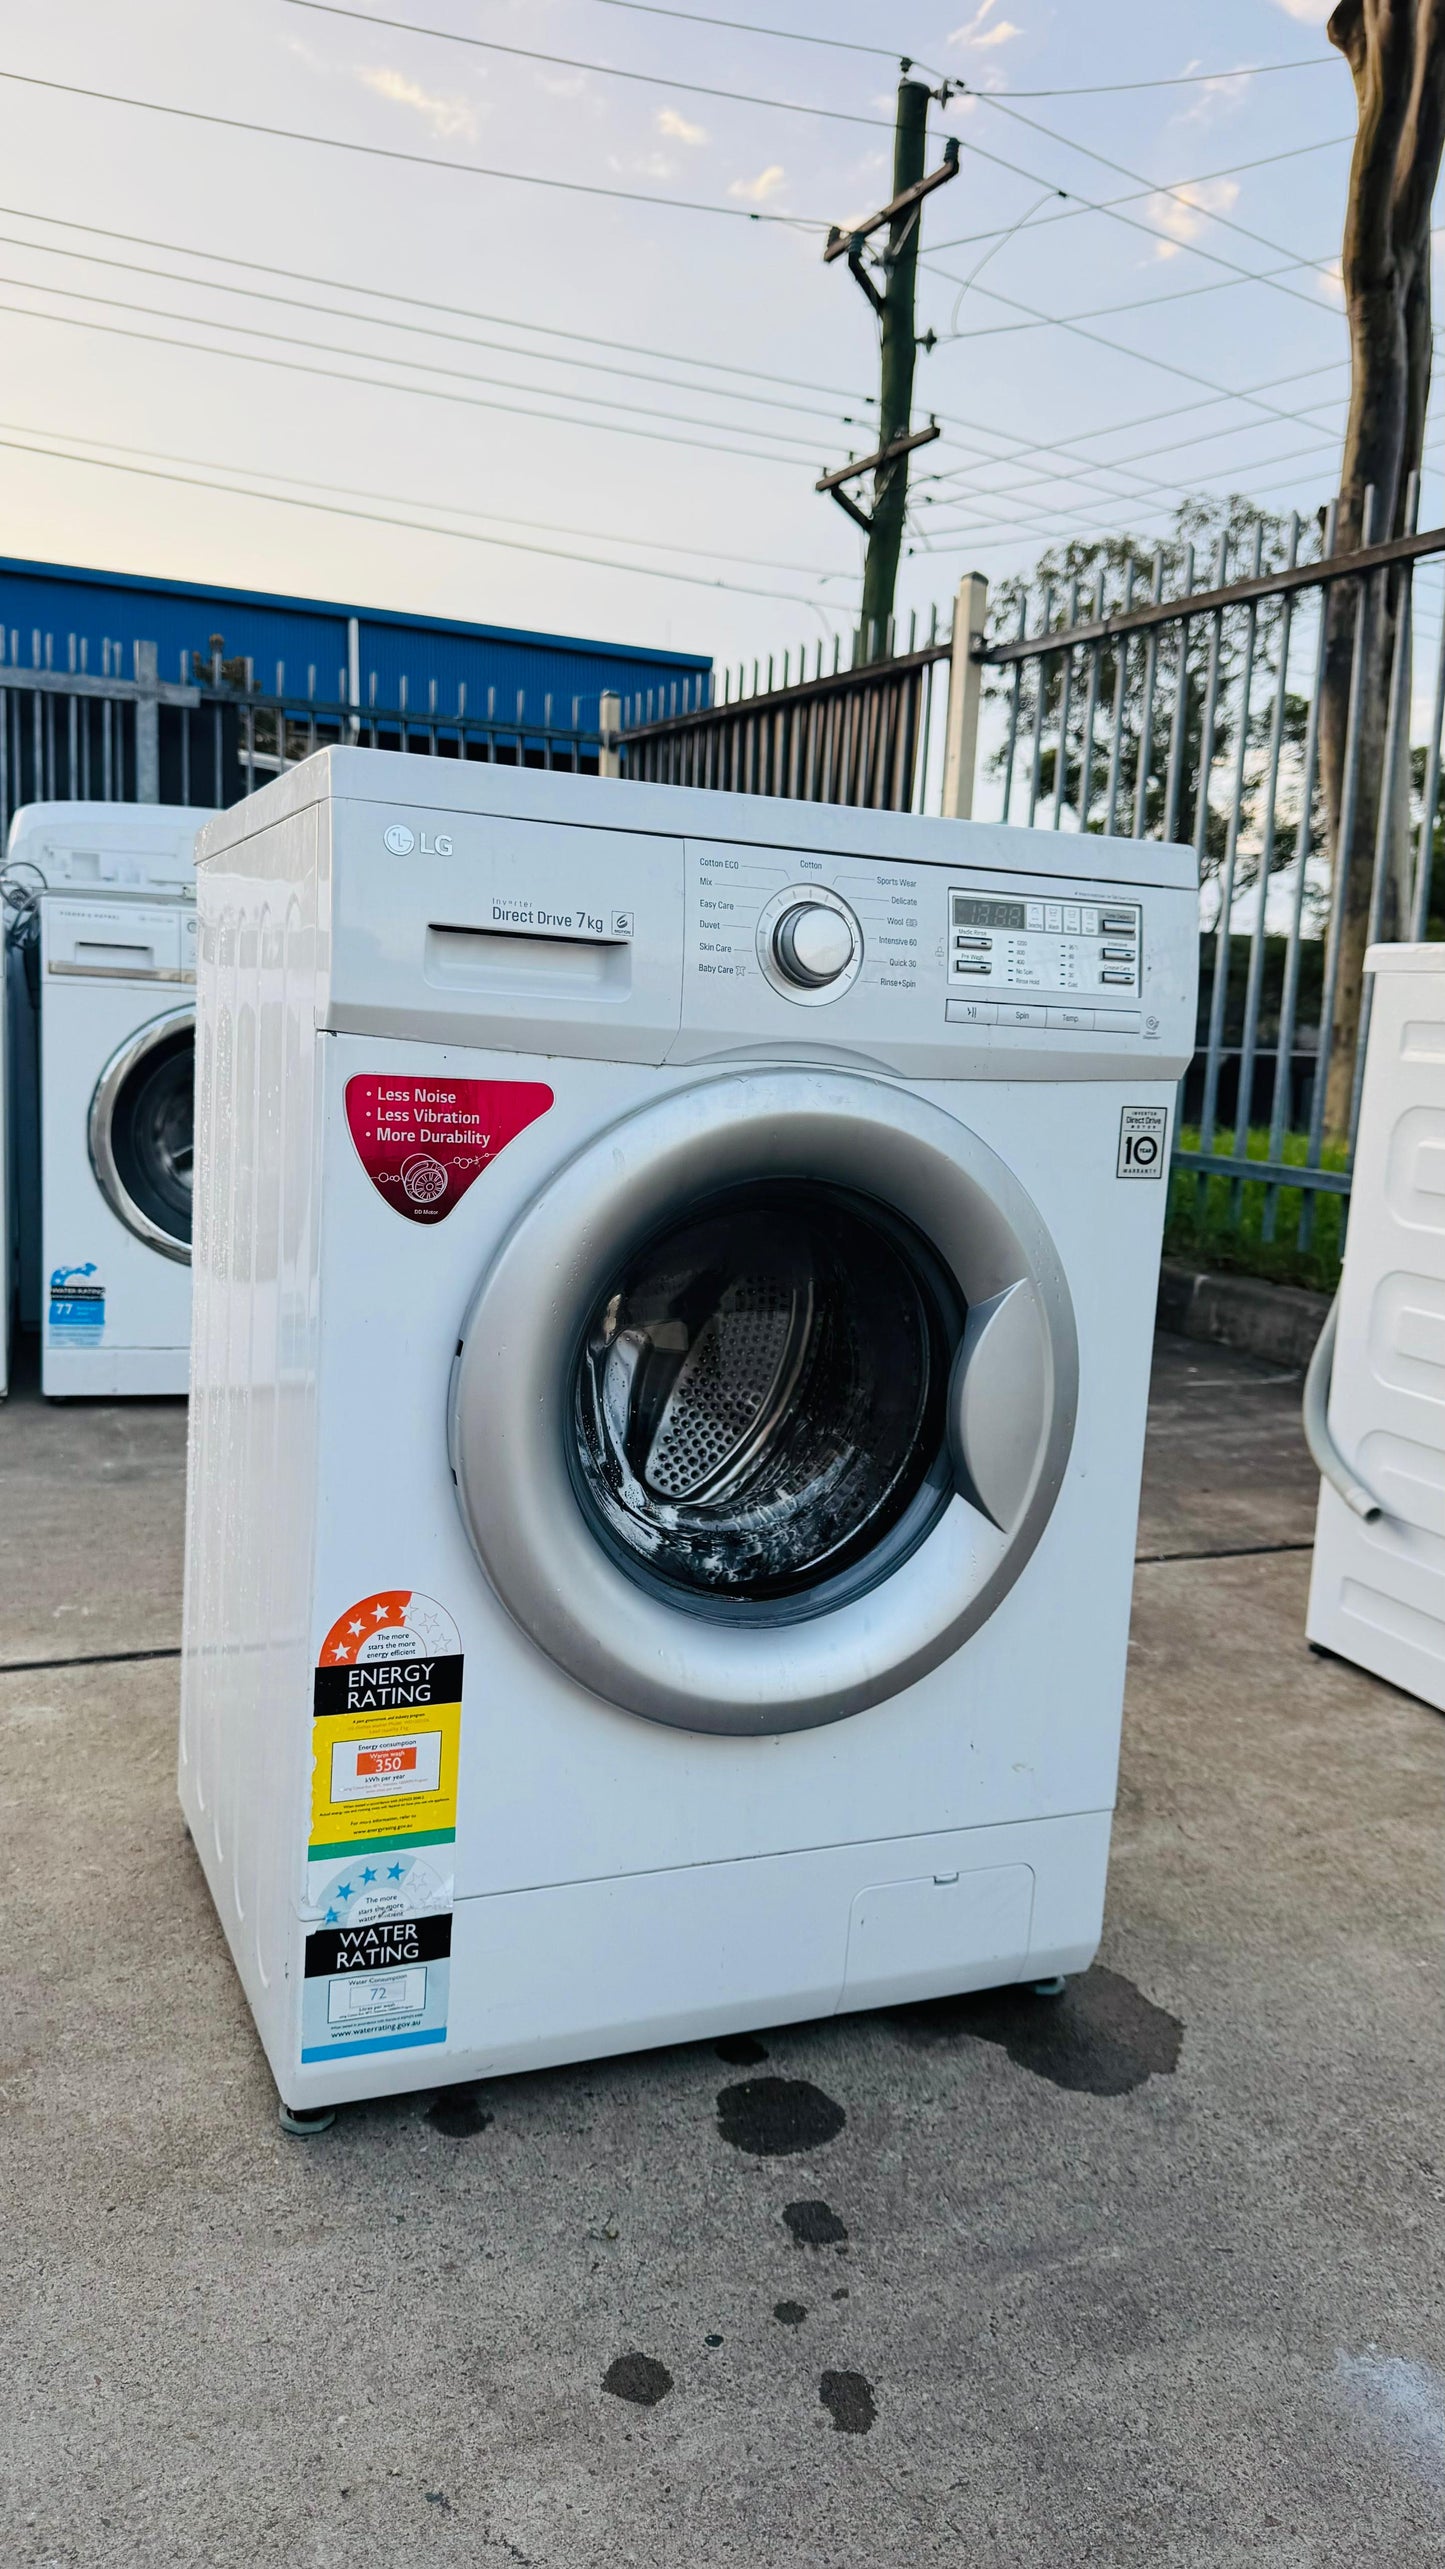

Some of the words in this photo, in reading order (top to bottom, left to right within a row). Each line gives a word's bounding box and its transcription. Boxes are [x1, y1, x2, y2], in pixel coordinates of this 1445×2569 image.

[419, 832, 454, 856] LG
[700, 858, 723, 868] Cotton
[724, 860, 739, 869] ECO
[800, 859, 822, 870] Cotton
[699, 877, 713, 886] Mix
[876, 876, 898, 886] Sports
[899, 878, 917, 887] Wear
[492, 897, 533, 908] Inverter
[700, 899, 717, 910] Easy
[718, 900, 734, 910] Care
[891, 896, 918, 906] Delicate
[492, 906, 534, 924] Direct
[537, 911, 572, 927] Drive
[887, 917, 904, 926] Wool
[699, 919, 720, 929] Duvet
[879, 936, 908, 946] Intensive
[909, 938, 917, 947] 60
[699, 942, 715, 952] Skin
[716, 943, 732, 953] Care
[889, 958, 908, 967] Quick
[908, 959, 917, 968] 30
[698, 963, 717, 974] Baby
[717, 965, 734, 975] Care
[880, 977, 916, 989] Rinse+Spin
[1015, 1011, 1029, 1020] Spin
[1062, 1014, 1079, 1023] Temp
[377, 1087, 410, 1102] Less
[414, 1088, 457, 1104] Noise
[377, 1107, 410, 1122] Less
[413, 1108, 480, 1125] Vibration
[1126, 1116, 1145, 1124] Direct
[1145, 1116, 1161, 1124] Drive
[376, 1127, 416, 1142] More
[420, 1128, 491, 1148] Durability
[1125, 1136, 1158, 1165] 10
[56, 1303, 73, 1315] 77
[377, 1633, 390, 1641] The
[391, 1632, 410, 1640] more
[368, 1643, 384, 1651] stars
[397, 1640, 416, 1648] more
[366, 1651, 388, 1659] energy
[390, 1648, 416, 1657] efficient
[348, 1663, 435, 1688] ENERGY
[347, 1684, 431, 1709] RATING
[379, 1740, 417, 1748] consumption
[376, 1757, 402, 1772] 350
[392, 1774, 406, 1782] year
[340, 1923, 418, 1949] WATER
[336, 1942, 419, 1969] RATING
[349, 1978, 368, 1986] Water
[369, 1974, 408, 1984] Consumption
[370, 1987, 387, 2001] 72
[331, 2020, 421, 2038] www.waterrating.gov.au
